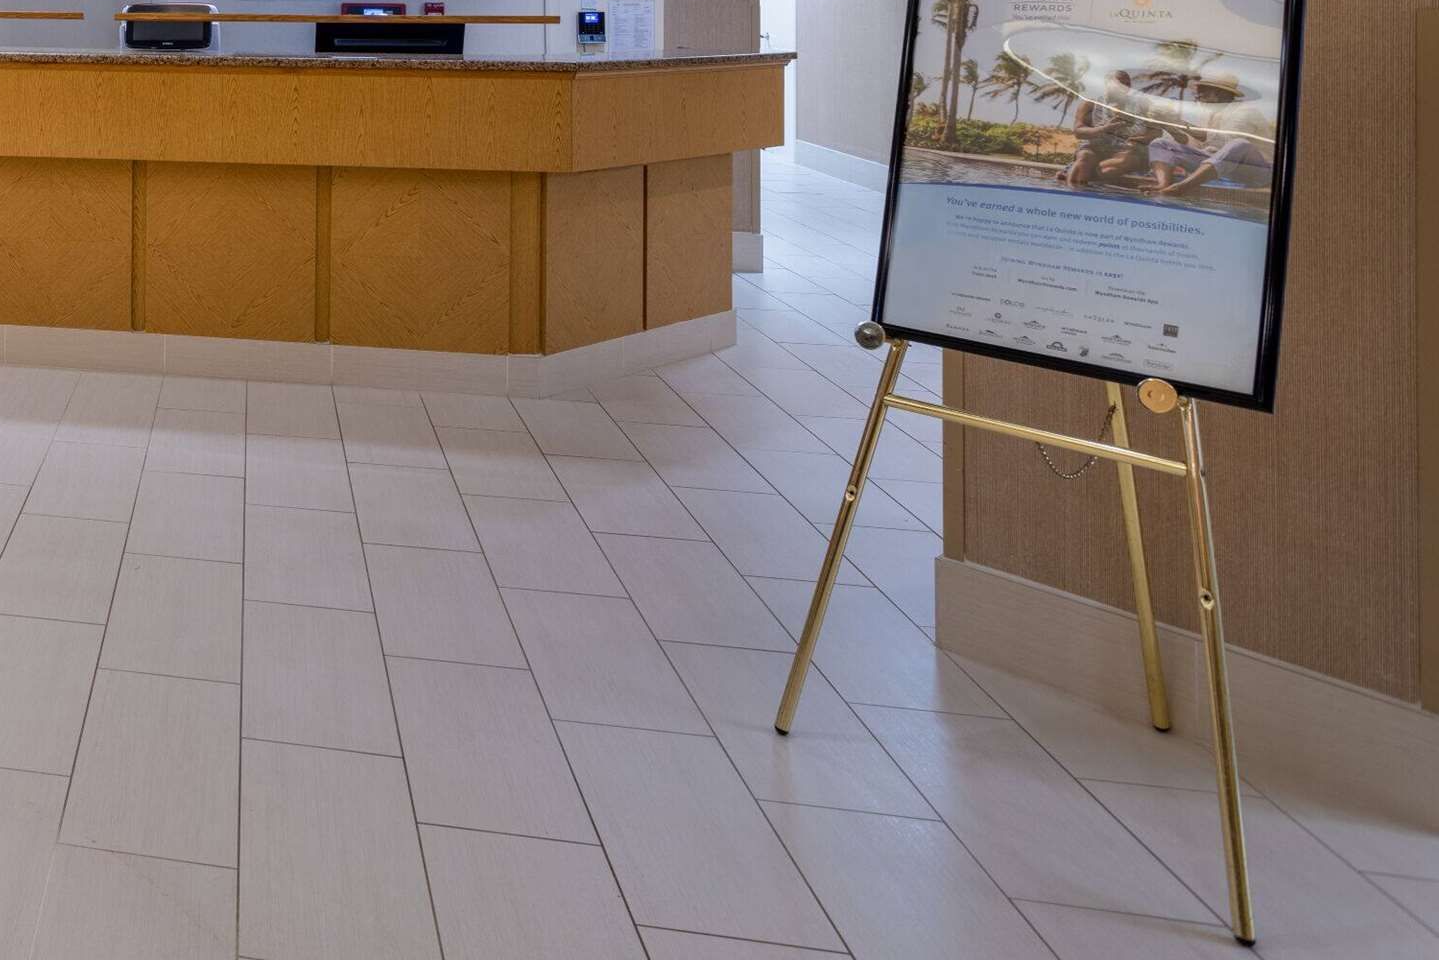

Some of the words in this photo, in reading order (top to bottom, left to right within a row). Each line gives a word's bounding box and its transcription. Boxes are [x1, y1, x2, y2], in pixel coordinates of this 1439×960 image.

[1014, 4, 1073, 12] REWARDS
[1120, 8, 1173, 19] QUINTA
[946, 196, 978, 208] You've
[980, 201, 1016, 212] earned
[1025, 207, 1057, 217] whole
[1084, 215, 1114, 225] world
[1116, 216, 1129, 226] of
[1130, 219, 1205, 236] possibilities.
